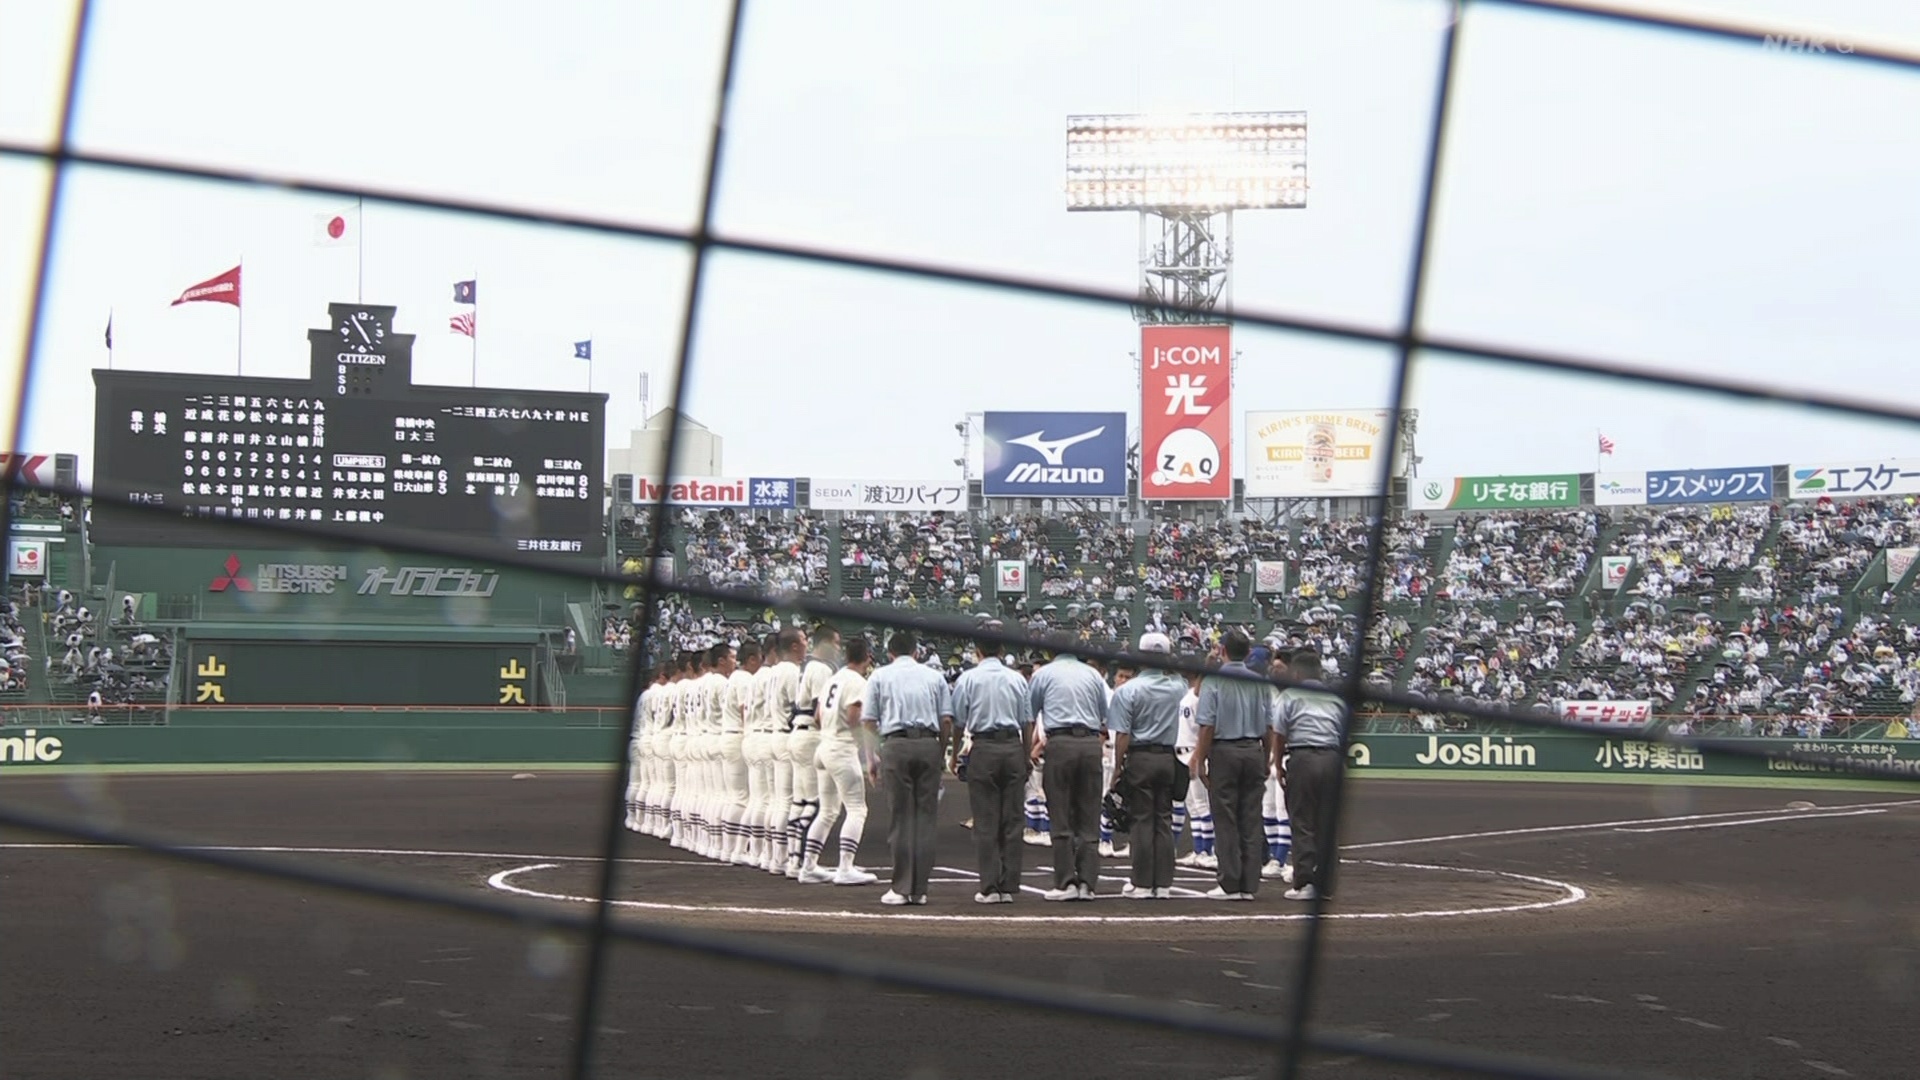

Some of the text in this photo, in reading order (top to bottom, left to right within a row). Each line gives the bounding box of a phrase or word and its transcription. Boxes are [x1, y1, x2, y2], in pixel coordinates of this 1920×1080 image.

[358, 312, 368, 320] 12
[376, 329, 384, 337] 3
[337, 353, 386, 365] CITIZEN
[1150, 346, 1220, 369] J:COM
[338, 365, 346, 374] B
[338, 375, 346, 384] S
[1165, 374, 1212, 415] 光
[203, 396, 213, 404] 二
[219, 396, 229, 405] 三
[234, 396, 246, 407] 四
[251, 398, 261, 407] 五
[267, 398, 277, 408] 六
[283, 399, 293, 409] 七
[298, 399, 309, 409] 八
[314, 400, 325, 410] 九
[570, 412, 578, 421] H
[581, 412, 589, 422] E
[1258, 415, 1381, 439] KIRIN'S PRIME BREW
[396, 431, 434, 441] 日大三
[186, 450, 321, 464] 5 8 6 7 2 3 9 1 4
[336, 457, 382, 466] UMPIRES
[1163, 454, 1213, 477] ZAQ
[185, 466, 320, 480] 9 6 8 3 7 2 5 4 1
[438, 470, 447, 482] 6
[509, 473, 519, 485] 10
[438, 482, 447, 494] 3
[579, 475, 588, 487] 8
[1649, 472, 1767, 499] シスメックス
[509, 485, 519, 496] 7
[579, 487, 588, 499] 5
[755, 481, 789, 498] 水素
[864, 484, 967, 505] 渡辺パイプ
[1473, 481, 1569, 502] りそな銀行
[1610, 486, 1642, 497] sysmex
[373, 489, 384, 522] 田中
[754, 498, 789, 506] エネルギー
[518, 540, 581, 551] 三井住友銀行
[258, 563, 347, 581] MITSUBISHI
[257, 578, 335, 595] ELECTRIC
[197, 656, 227, 703] 山九
[500, 658, 526, 705] 山九
[1416, 735, 1536, 766] Joshin
[1595, 740, 1704, 770] 小野薬品
